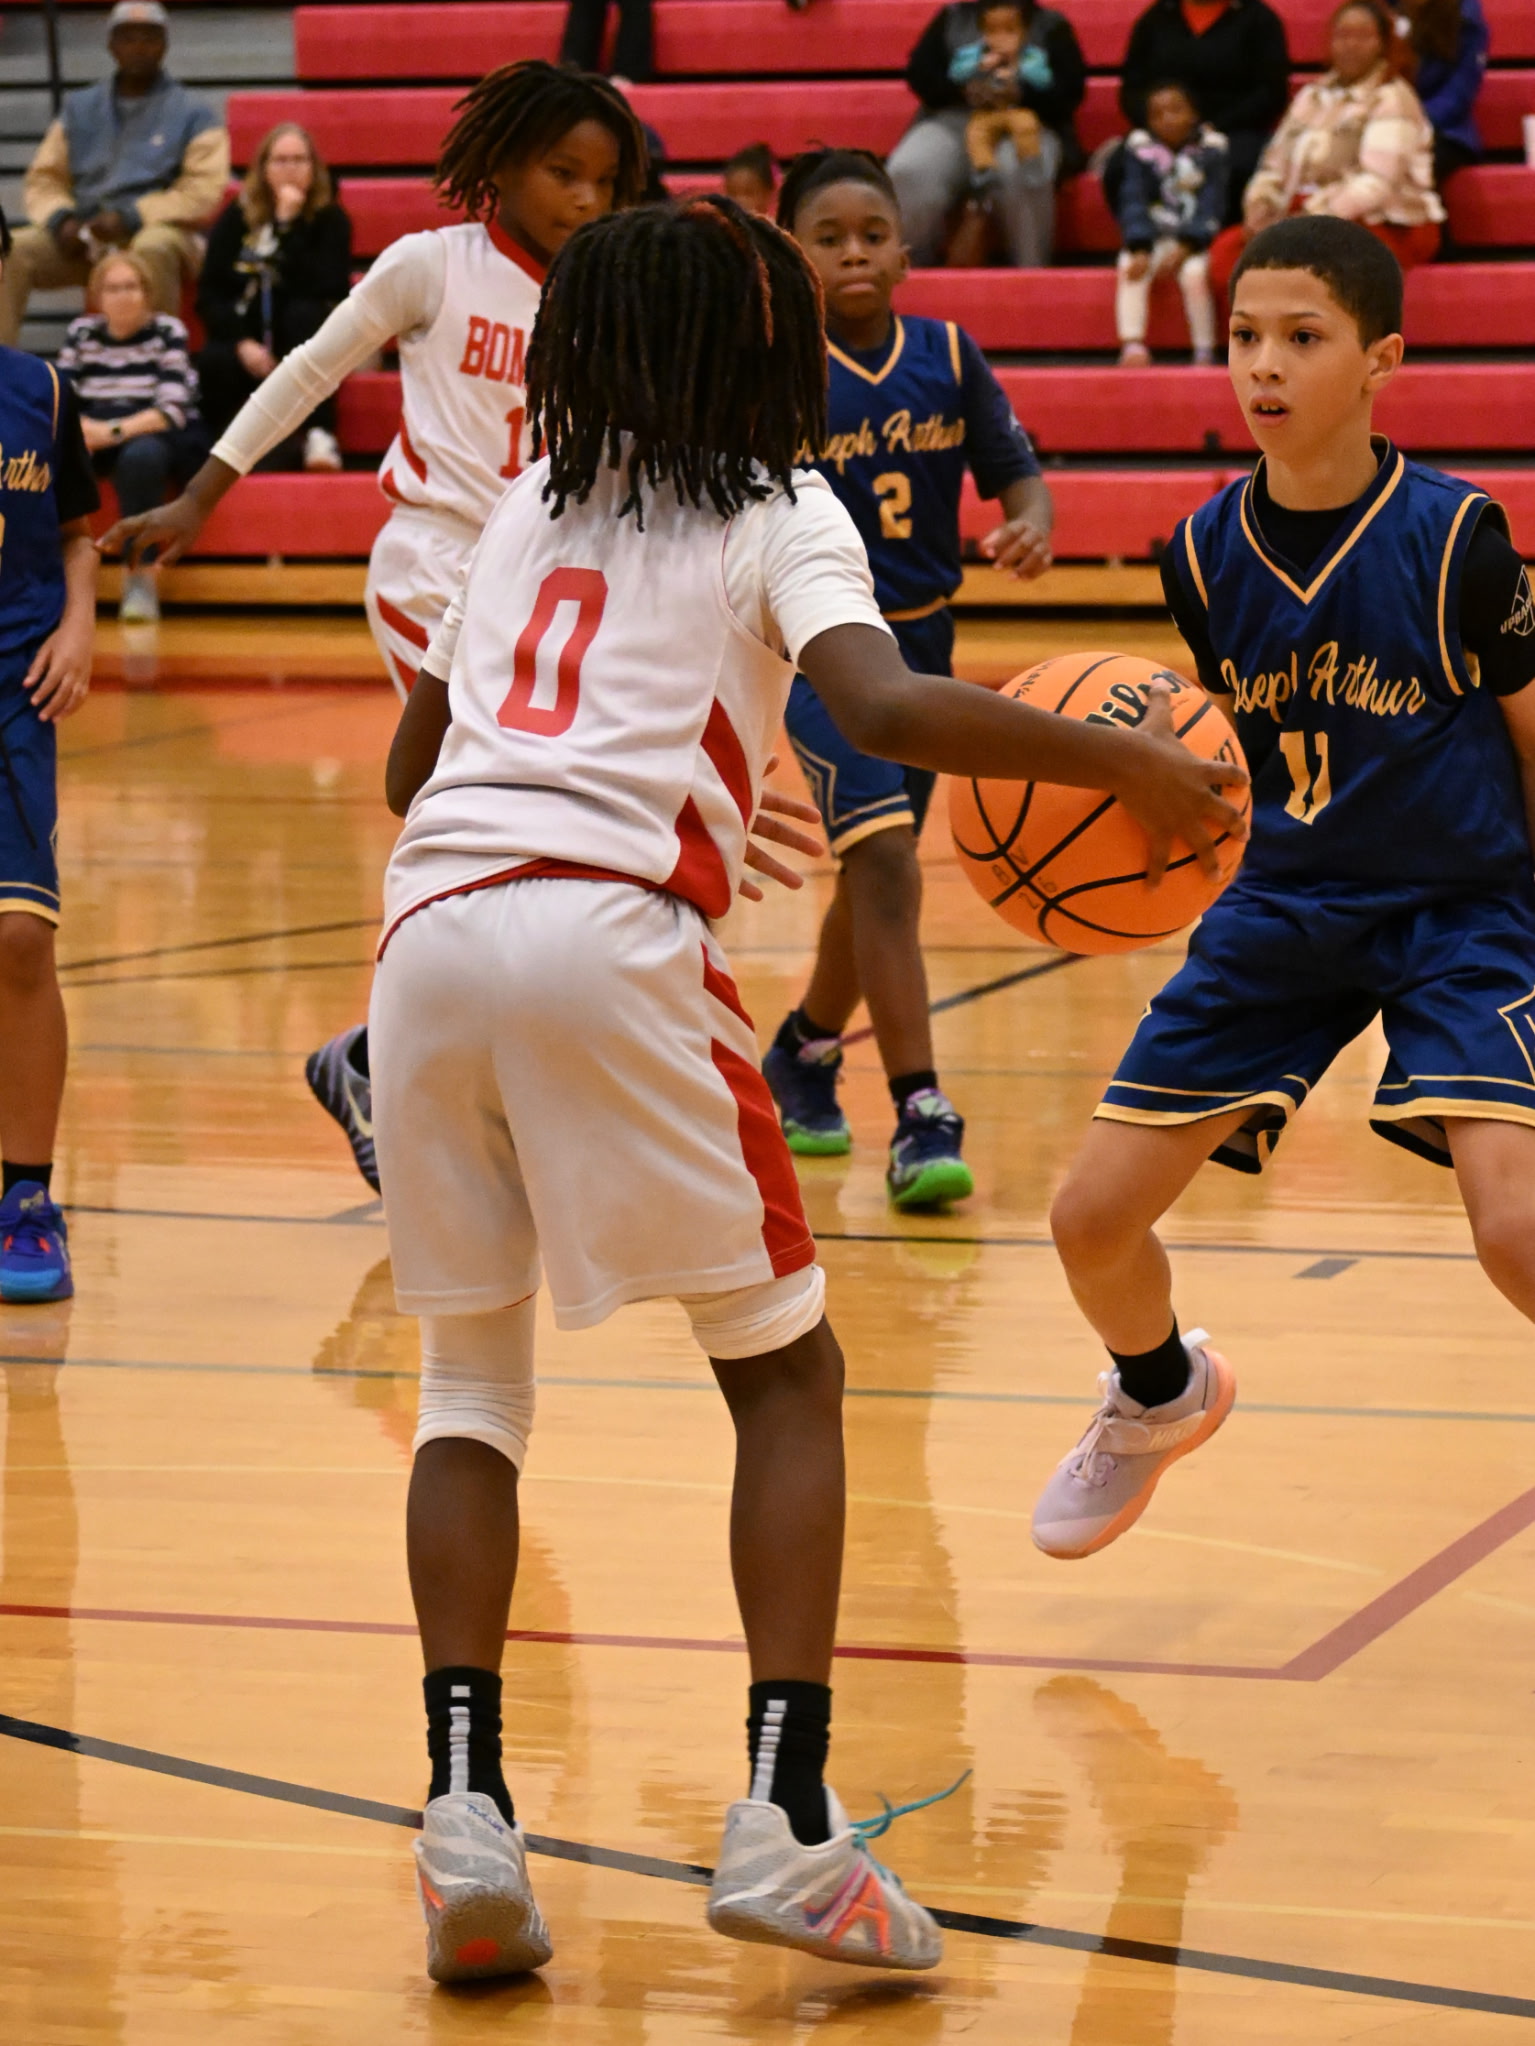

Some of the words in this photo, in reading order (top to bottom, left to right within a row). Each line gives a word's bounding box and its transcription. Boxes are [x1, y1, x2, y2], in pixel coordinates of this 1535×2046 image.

[0, 448, 52, 493] rthur
[873, 470, 913, 539] 2
[496, 566, 609, 737] 0
[1307, 640, 1426, 717] Arthur
